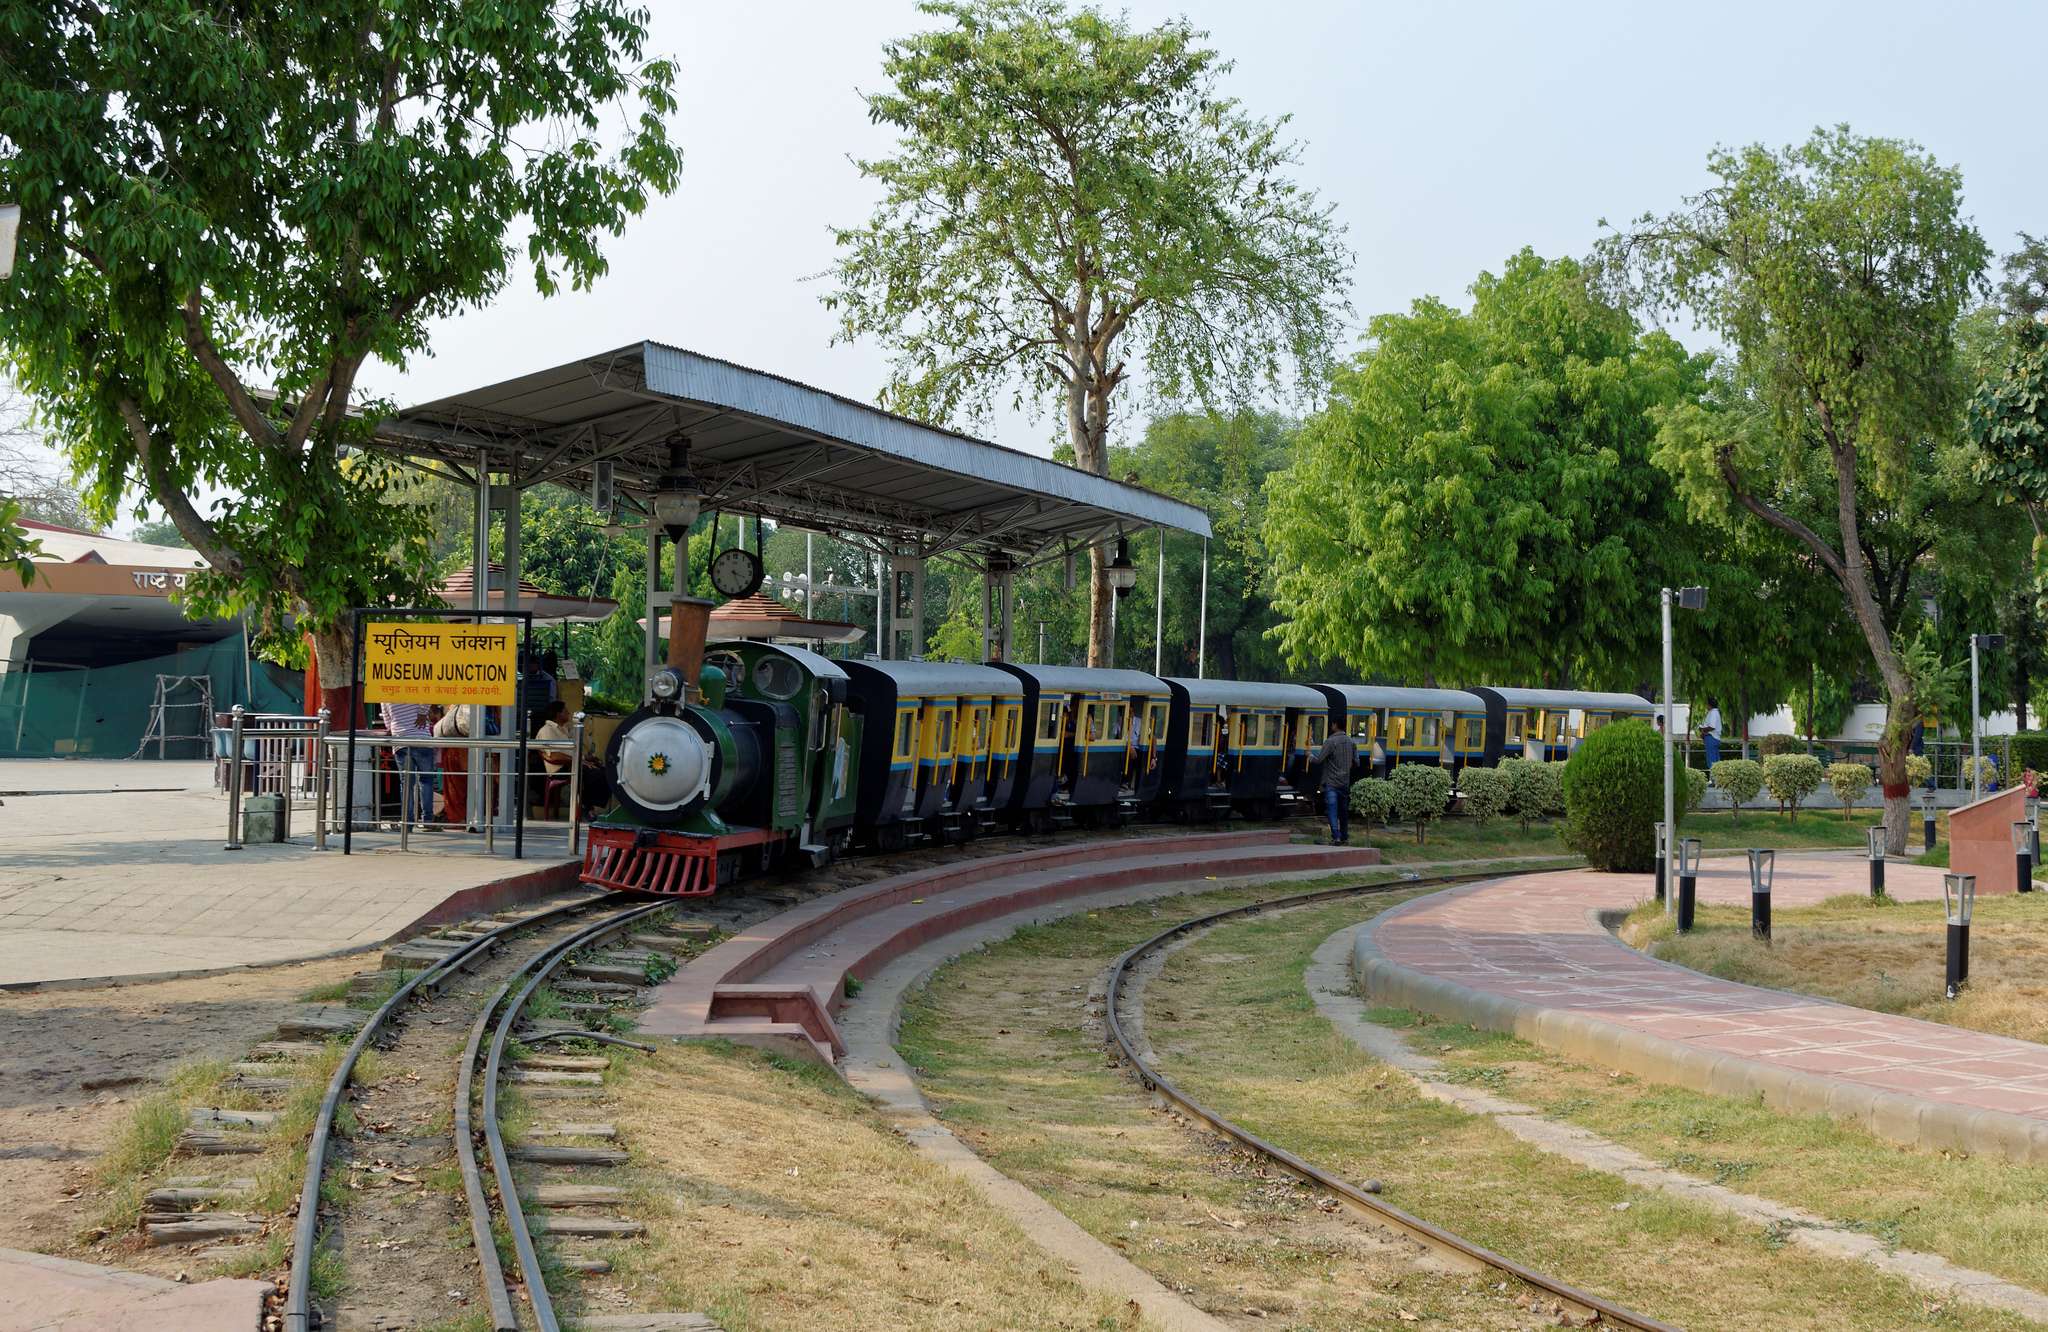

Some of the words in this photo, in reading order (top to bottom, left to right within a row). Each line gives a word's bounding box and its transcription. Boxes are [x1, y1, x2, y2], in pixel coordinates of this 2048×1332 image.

[372, 628, 440, 655] म्यूज़ियम
[450, 630, 507, 651] जंक्शन
[372, 663, 433, 680] MUSEUM
[437, 664, 507, 681] JUNCTION
